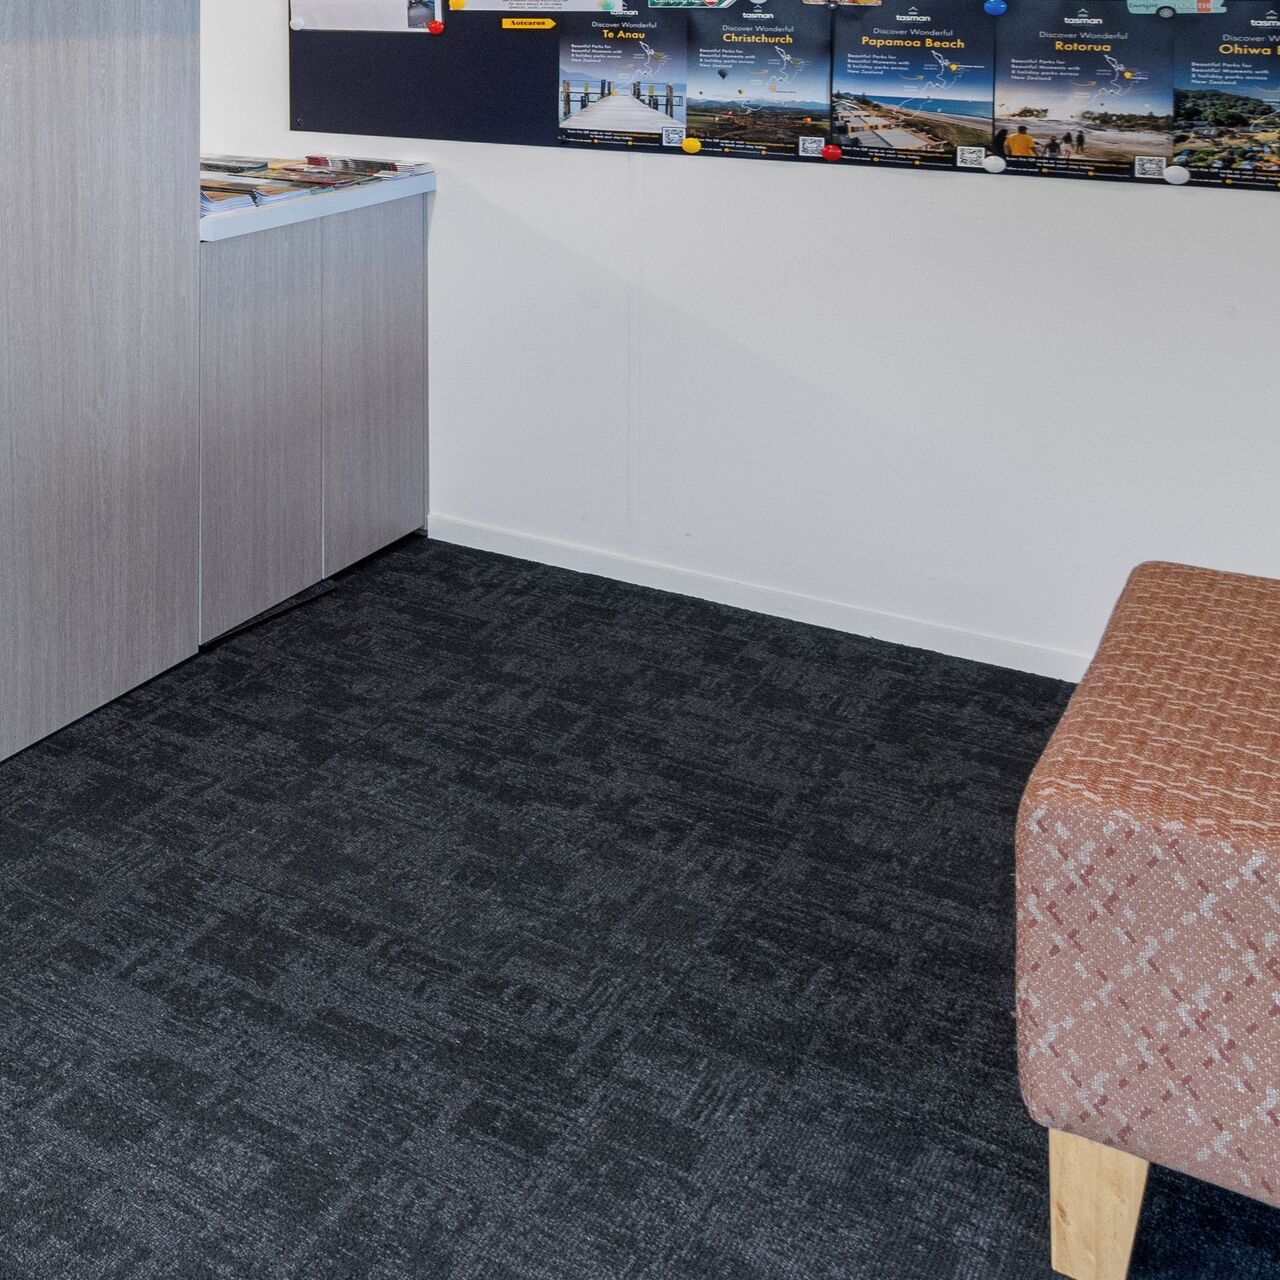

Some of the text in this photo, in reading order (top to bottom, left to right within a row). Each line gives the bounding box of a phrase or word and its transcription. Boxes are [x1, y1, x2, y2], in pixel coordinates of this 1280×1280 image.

[722, 24, 753, 32] Discover
[873, 27, 907, 35] Discover
[602, 29, 645, 39] Te Anau
[722, 33, 793, 44] Christchurch
[1039, 31, 1128, 40] Discover Wonderful
[1222, 34, 1265, 42] Discover
[861, 37, 965, 48] Papamoa Beach
[1055, 41, 1112, 52] Rotorua
[1218, 43, 1272, 55] Ohiwa
